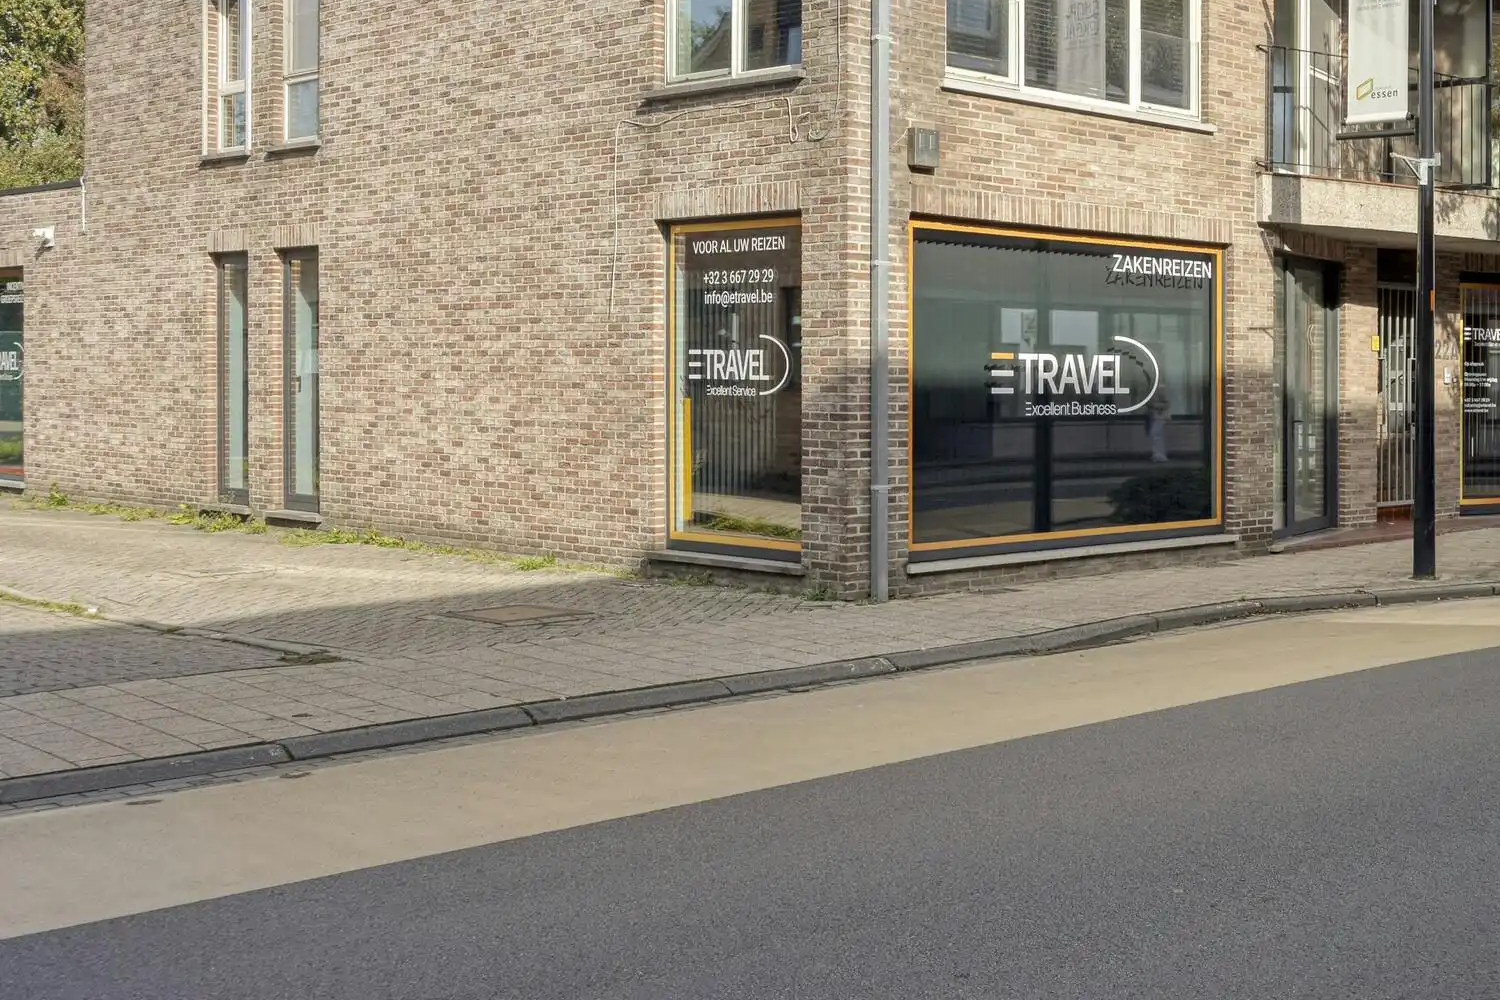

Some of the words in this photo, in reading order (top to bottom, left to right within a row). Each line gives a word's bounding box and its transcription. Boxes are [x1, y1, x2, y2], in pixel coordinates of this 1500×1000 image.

[1371, 90, 1398, 99] essen
[692, 240, 719, 255] VOOR
[720, 239, 732, 253] AL
[733, 238, 750, 252] UW
[751, 236, 785, 251] REIZEN
[1112, 254, 1212, 279] ZAKENREIZEN
[703, 271, 720, 285] +32
[721, 270, 728, 284] 3
[729, 270, 746, 284] 667
[748, 269, 760, 283] 29
[762, 268, 774, 283] 29
[704, 289, 773, 307] info@etravel.be
[706, 385, 732, 396] Excellent
[732, 385, 756, 396] Service
[1025, 401, 1071, 416] Excellent
[1071, 401, 1117, 416] Business
